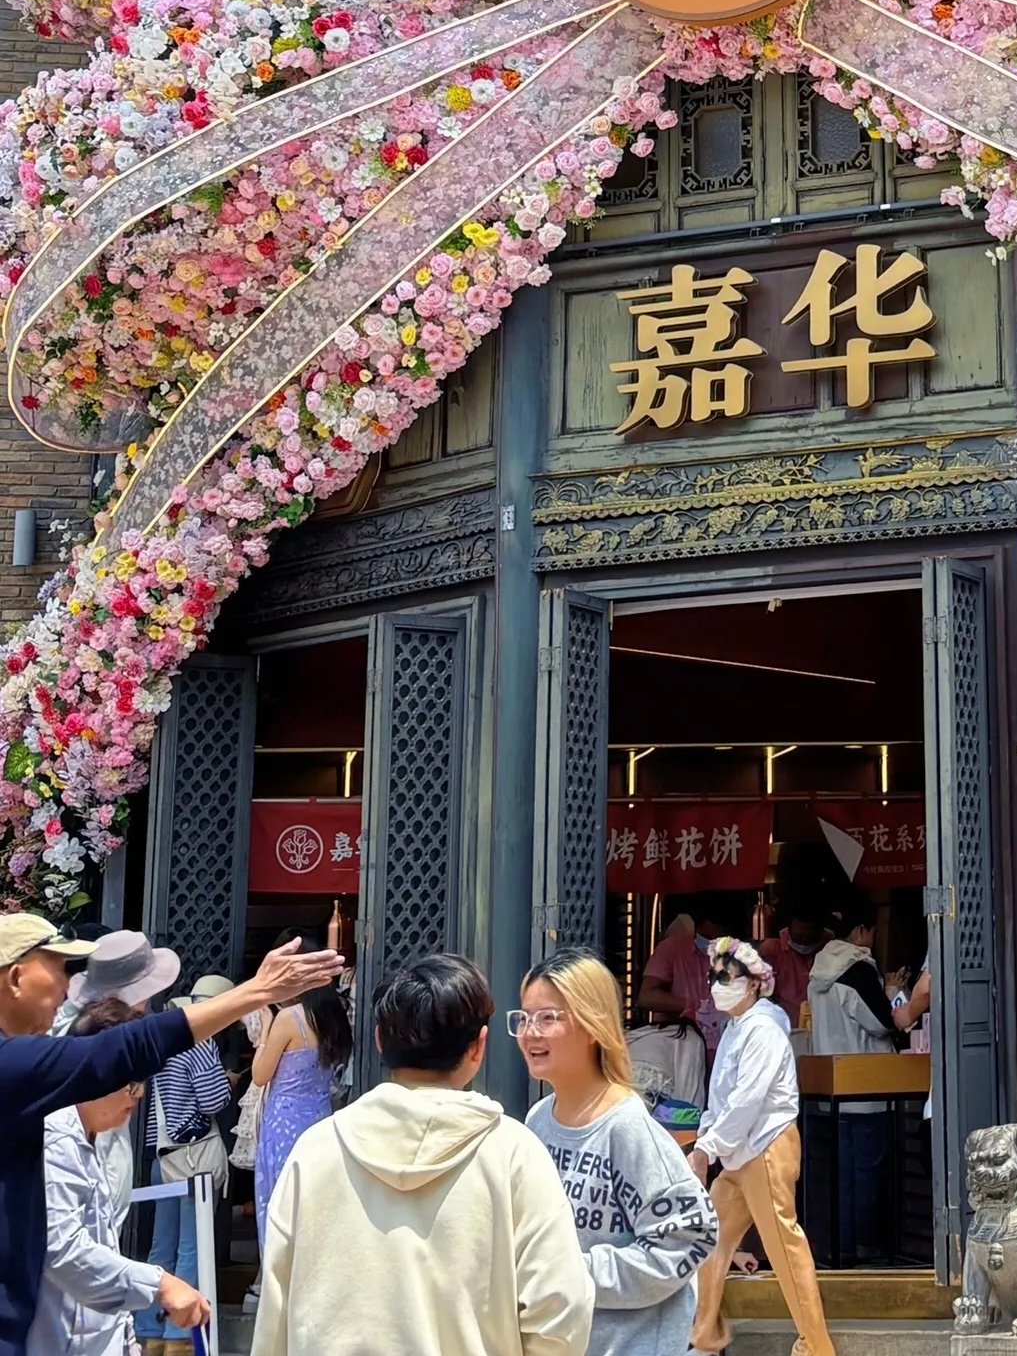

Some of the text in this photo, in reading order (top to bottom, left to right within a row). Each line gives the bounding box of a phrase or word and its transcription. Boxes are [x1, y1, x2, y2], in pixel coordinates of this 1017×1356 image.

[609, 244, 939, 436] 嘉华
[605, 824, 743, 870] 烤鲜花饼
